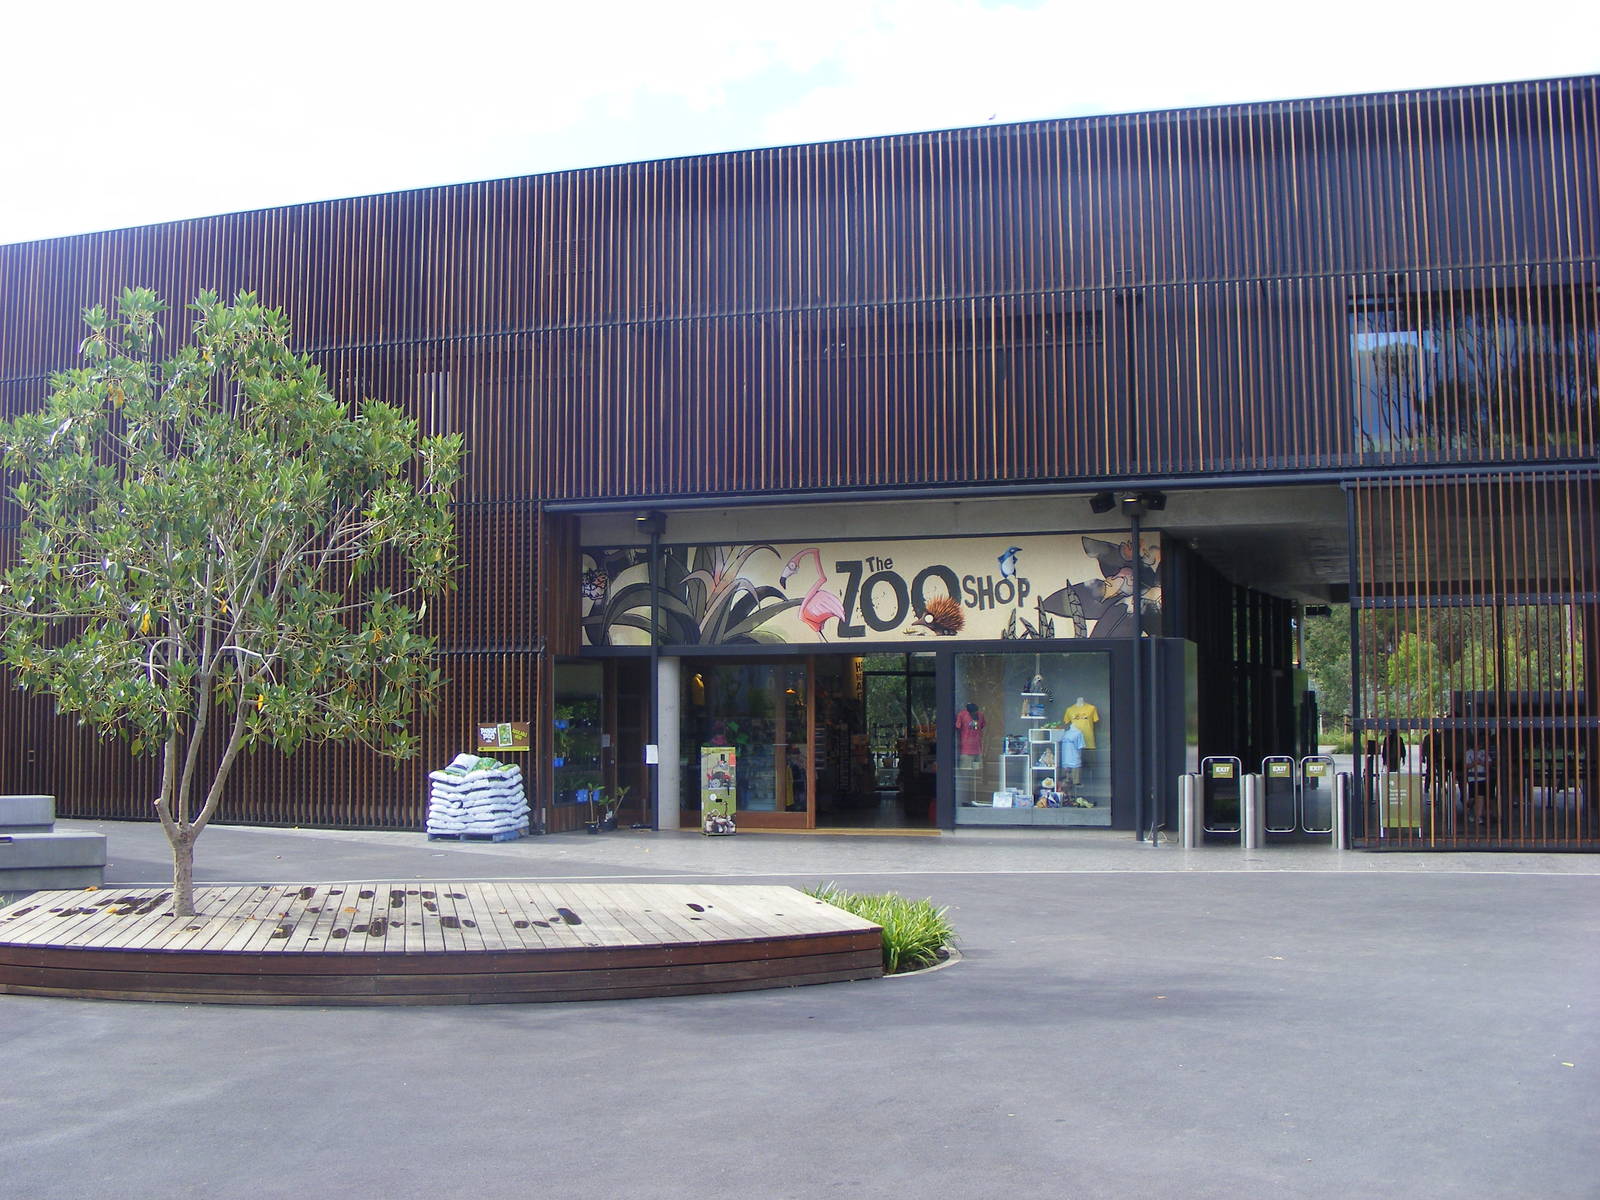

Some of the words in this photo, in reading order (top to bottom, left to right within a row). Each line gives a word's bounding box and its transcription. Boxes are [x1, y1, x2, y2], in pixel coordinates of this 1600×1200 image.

[866, 556, 893, 572] The
[836, 560, 961, 638] ZOO
[962, 574, 1030, 611] SHOP
